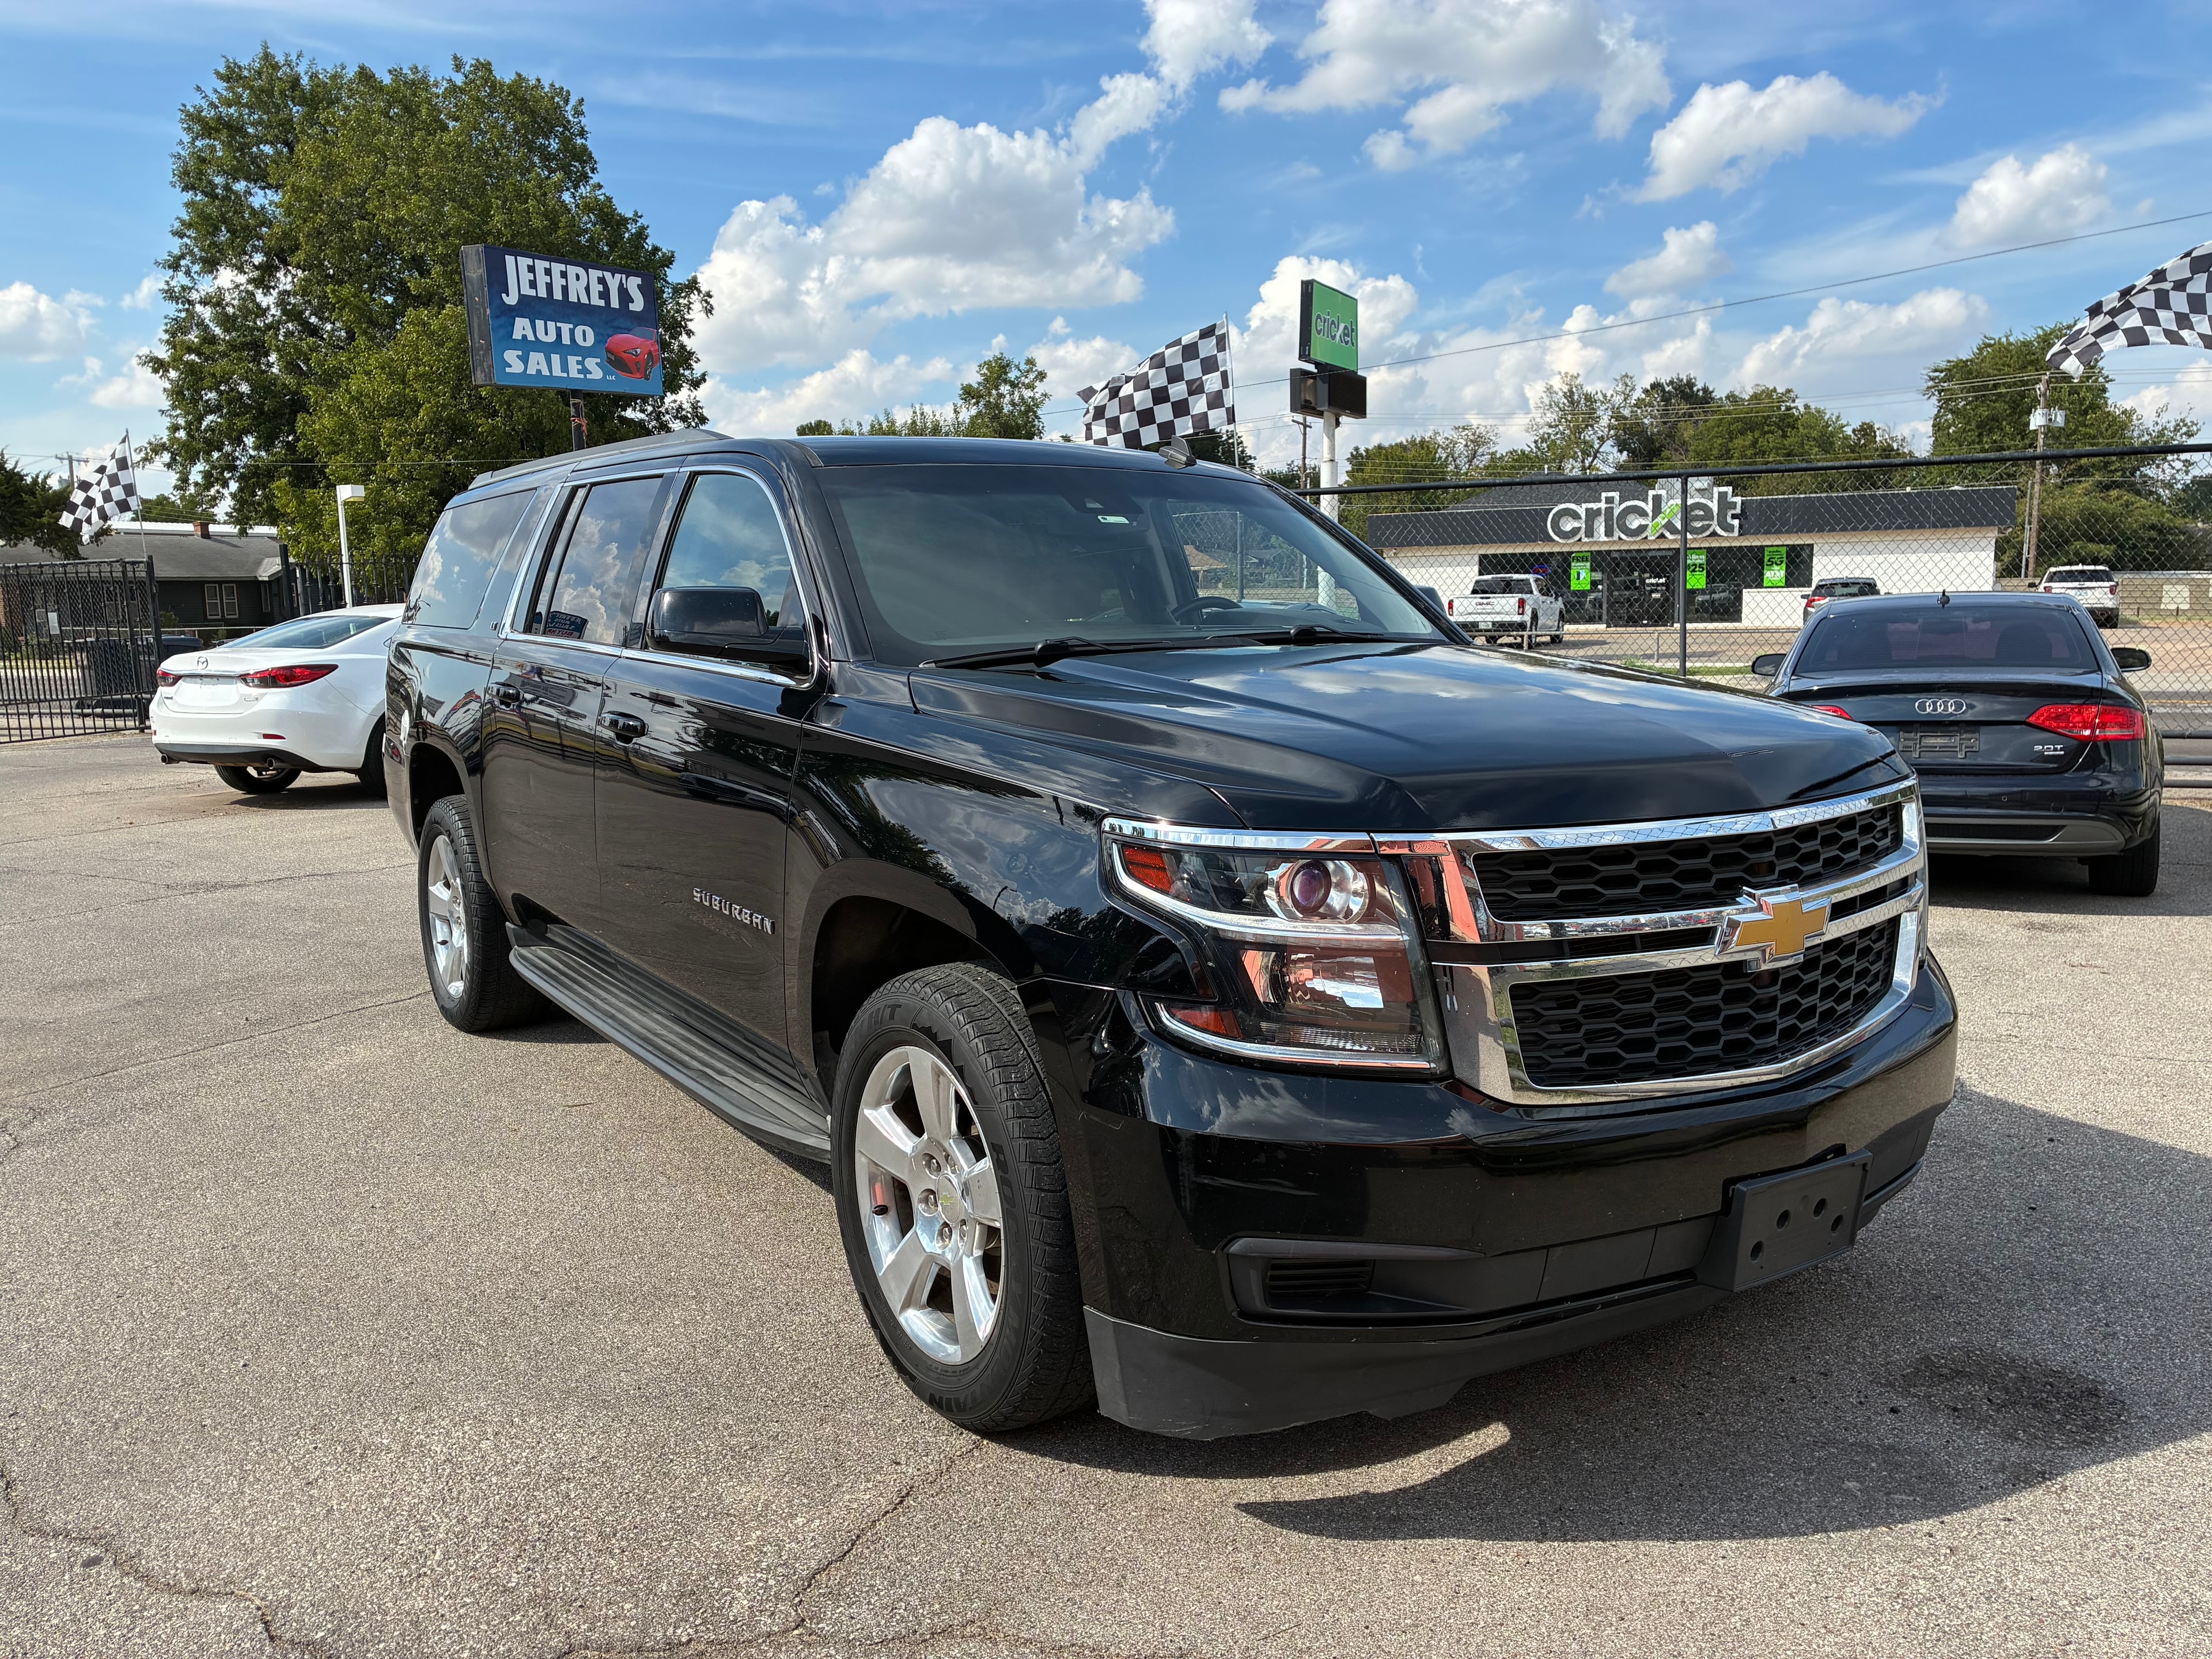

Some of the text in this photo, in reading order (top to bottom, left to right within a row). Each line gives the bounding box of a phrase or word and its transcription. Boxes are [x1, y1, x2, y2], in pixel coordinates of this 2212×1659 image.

[502, 255, 644, 312] JEFFREY'S
[512, 317, 594, 347] AUTO
[1315, 310, 1355, 349] cricket
[503, 349, 603, 380] SALES
[1547, 487, 1741, 543] cricket
[1687, 563, 1705, 573] $25
[1766, 557, 1785, 566] 5G
[693, 888, 775, 934] SUBURBAN
[868, 1004, 902, 1031] H/T
